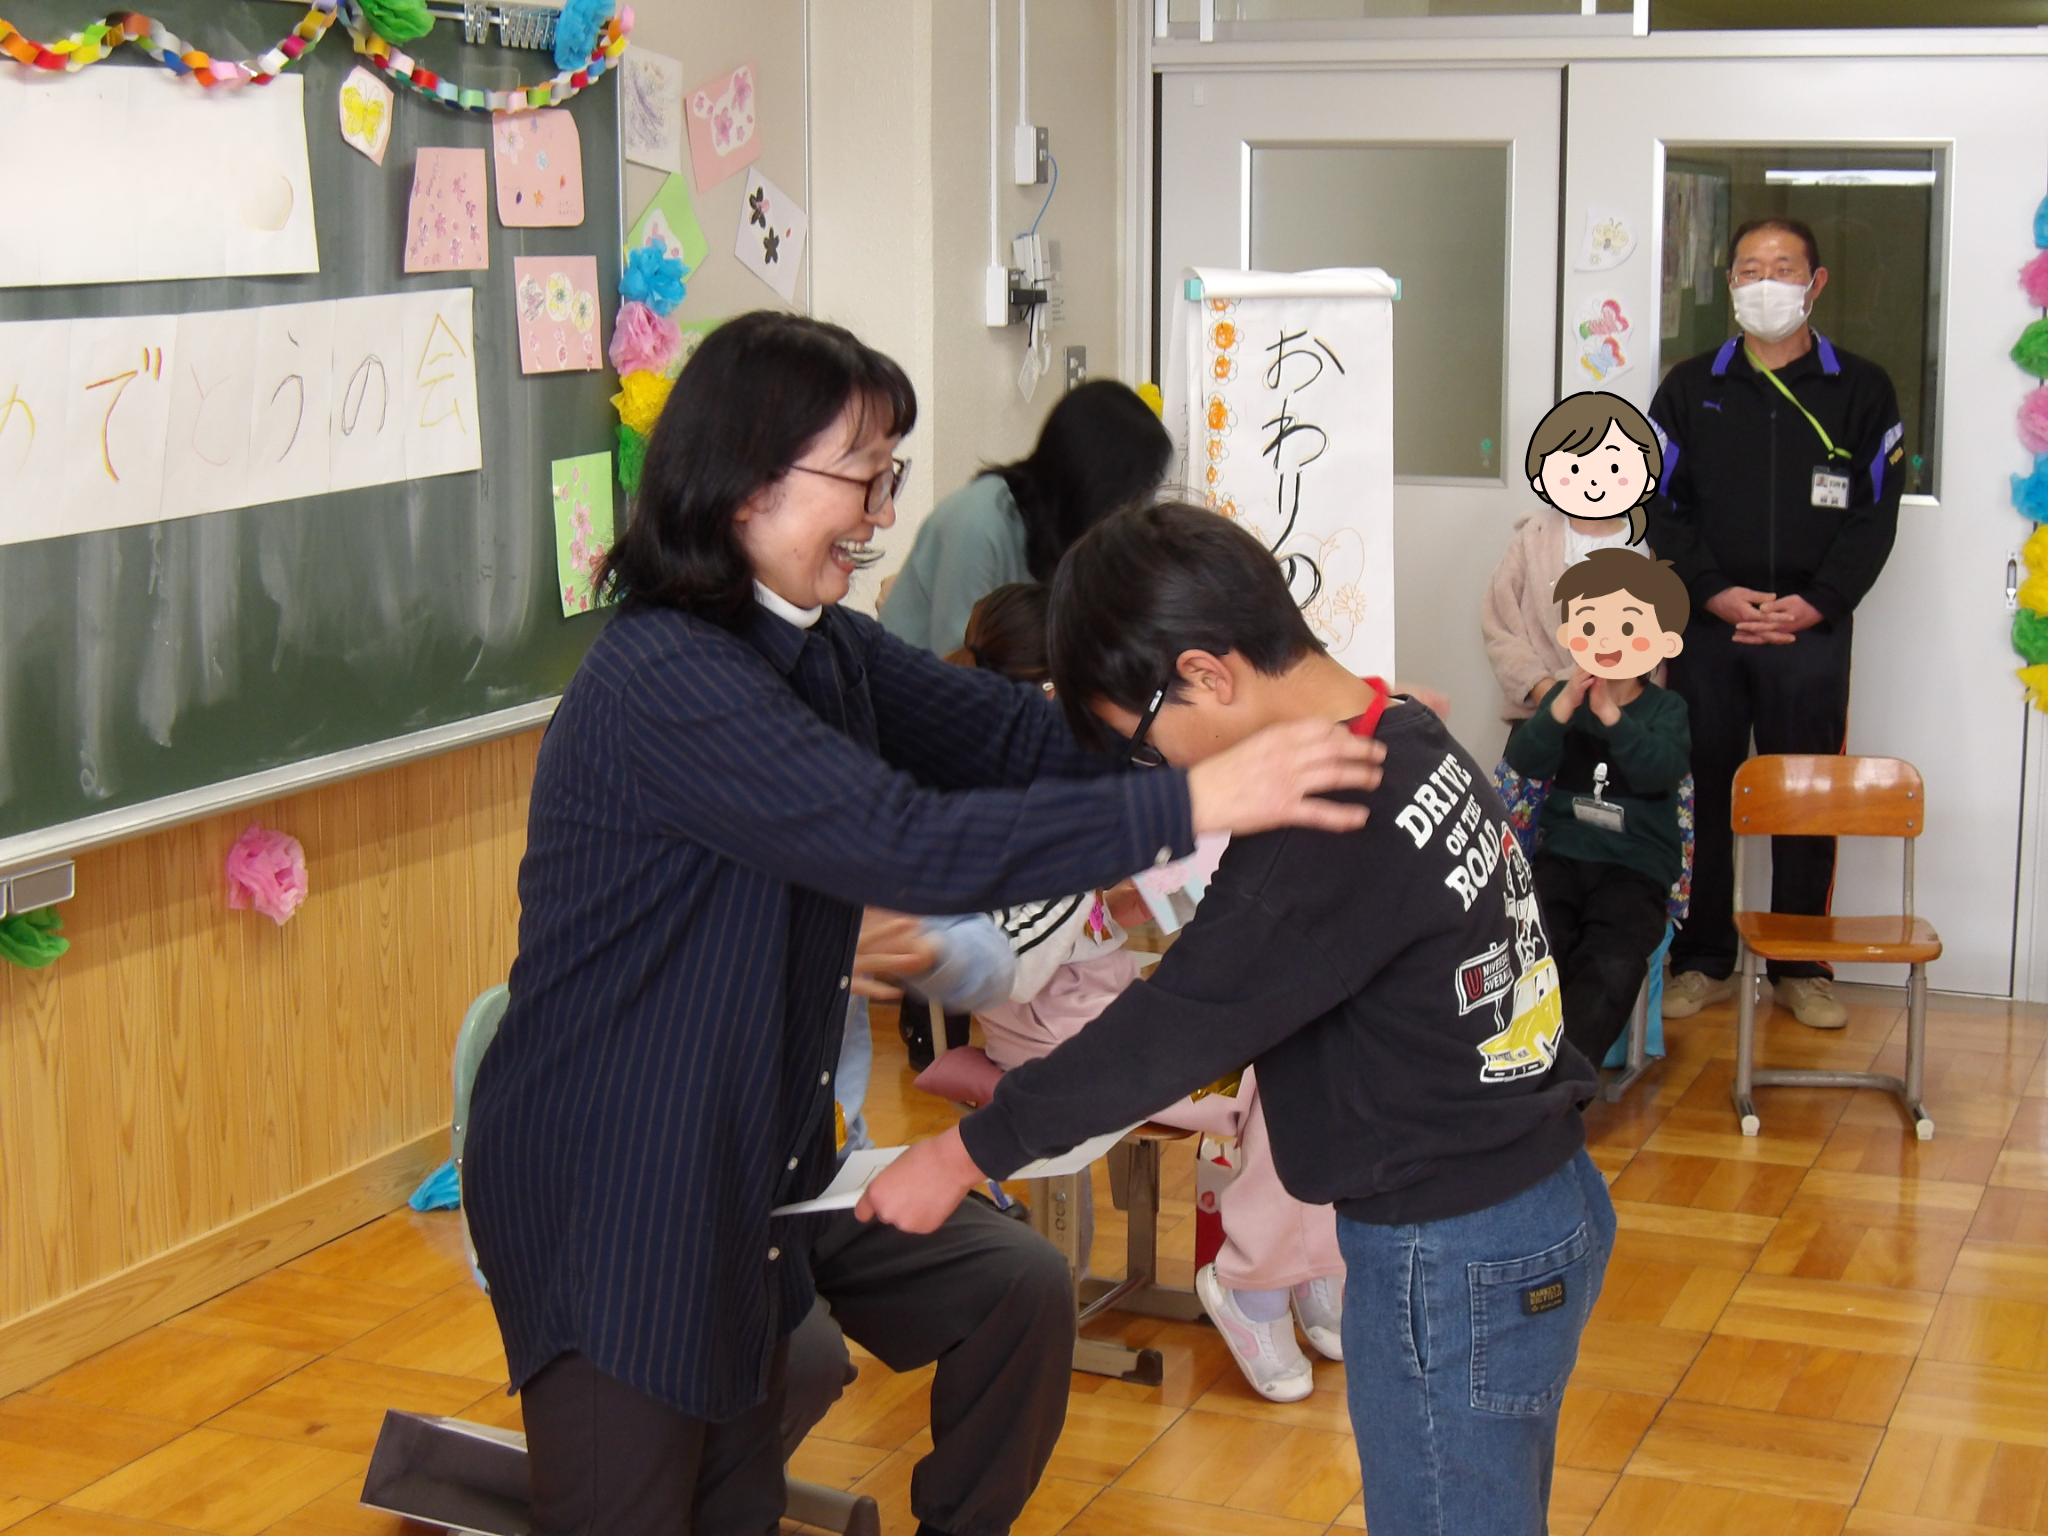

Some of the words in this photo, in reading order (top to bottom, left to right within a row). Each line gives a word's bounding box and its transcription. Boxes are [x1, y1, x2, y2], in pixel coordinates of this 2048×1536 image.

[1395, 753, 1473, 849] DRIVE
[1446, 821, 1470, 856] ON
[1461, 793, 1482, 833] THE
[1445, 819, 1501, 913] ROAD
